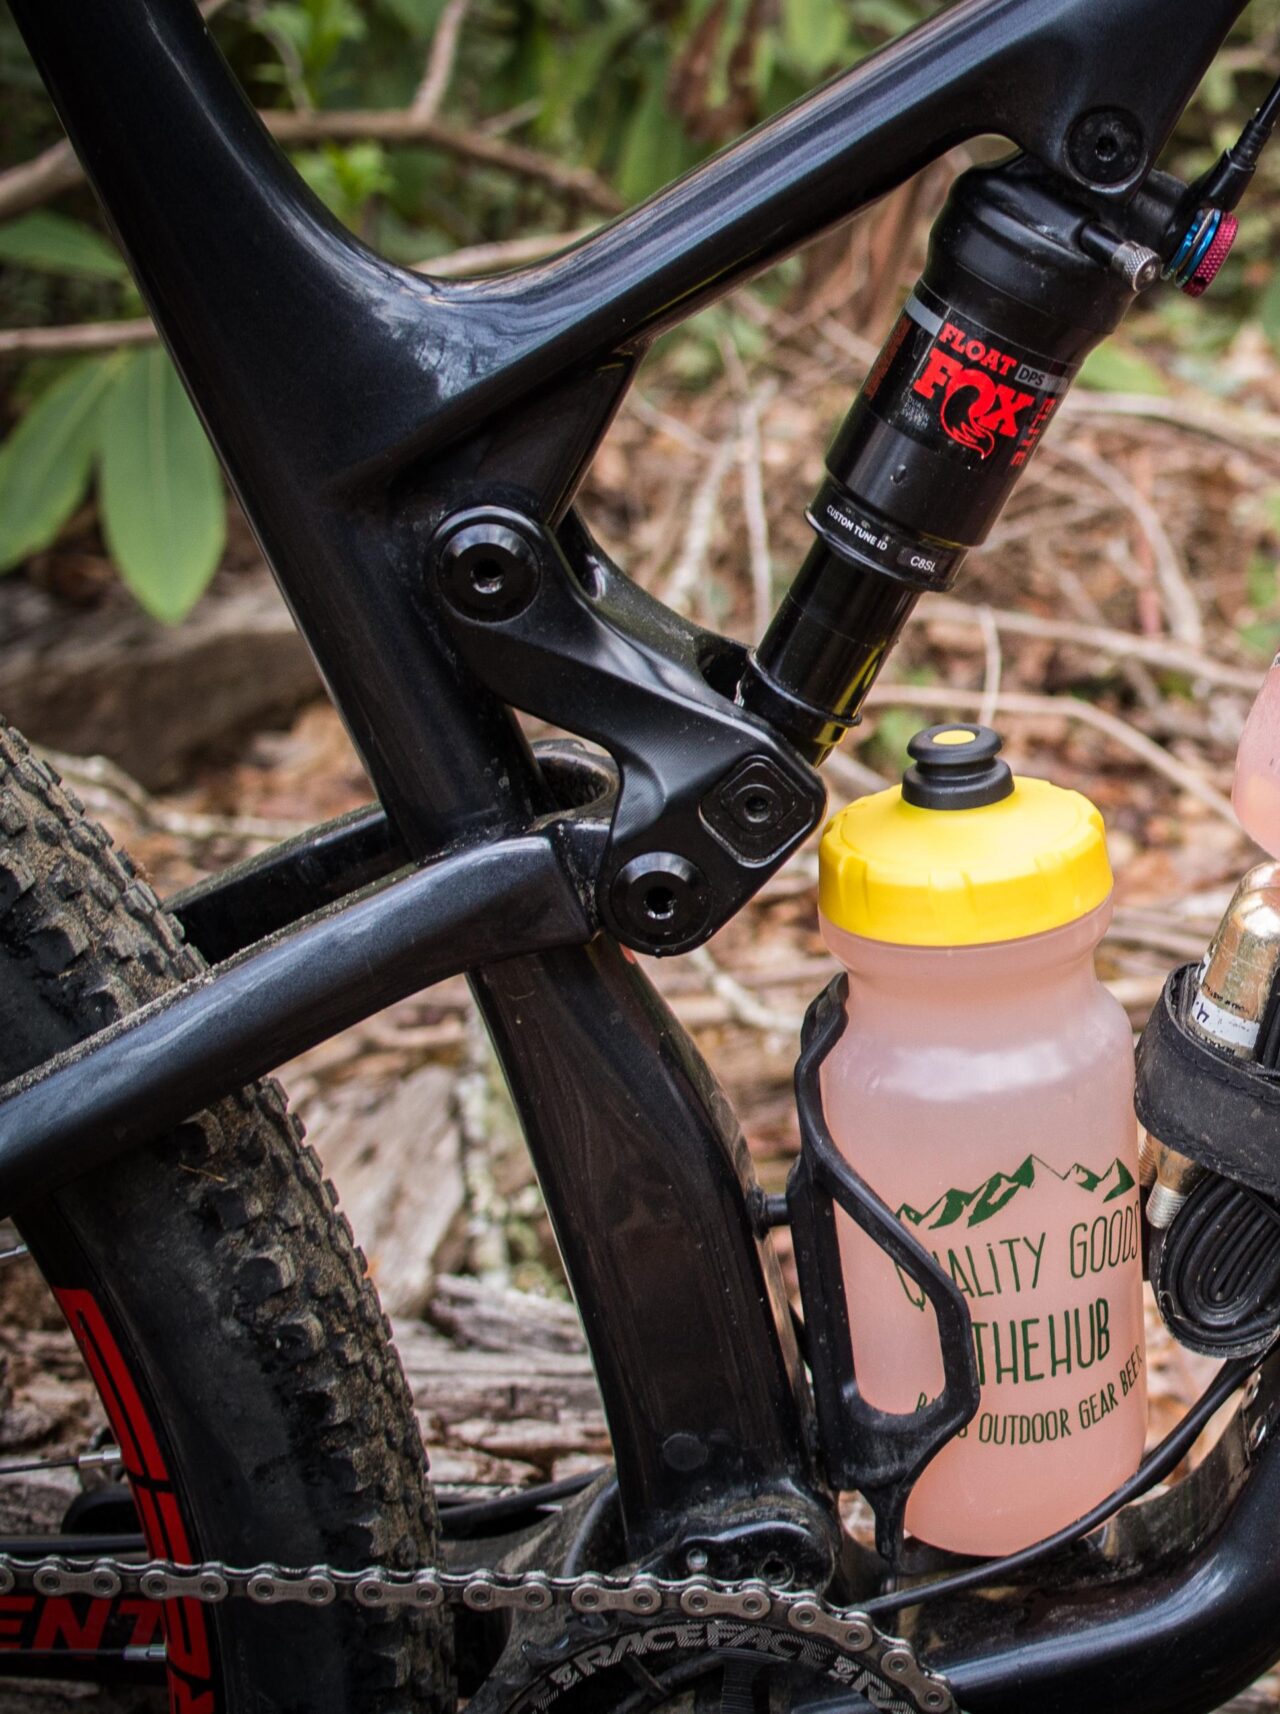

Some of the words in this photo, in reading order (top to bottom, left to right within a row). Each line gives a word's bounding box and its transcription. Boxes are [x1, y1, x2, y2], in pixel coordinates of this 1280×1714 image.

[938, 322, 1017, 377] FLOAT
[1018, 367, 1045, 387] DPS
[912, 347, 1036, 460] FOX
[826, 504, 854, 532] CUSTOM
[854, 525, 878, 546] TUNE
[876, 537, 888, 551] ID
[1070, 1200, 1139, 1279] GOODS
[978, 1409, 1072, 1446] OUTDOOR
[1078, 1382, 1118, 1429] GEAR
